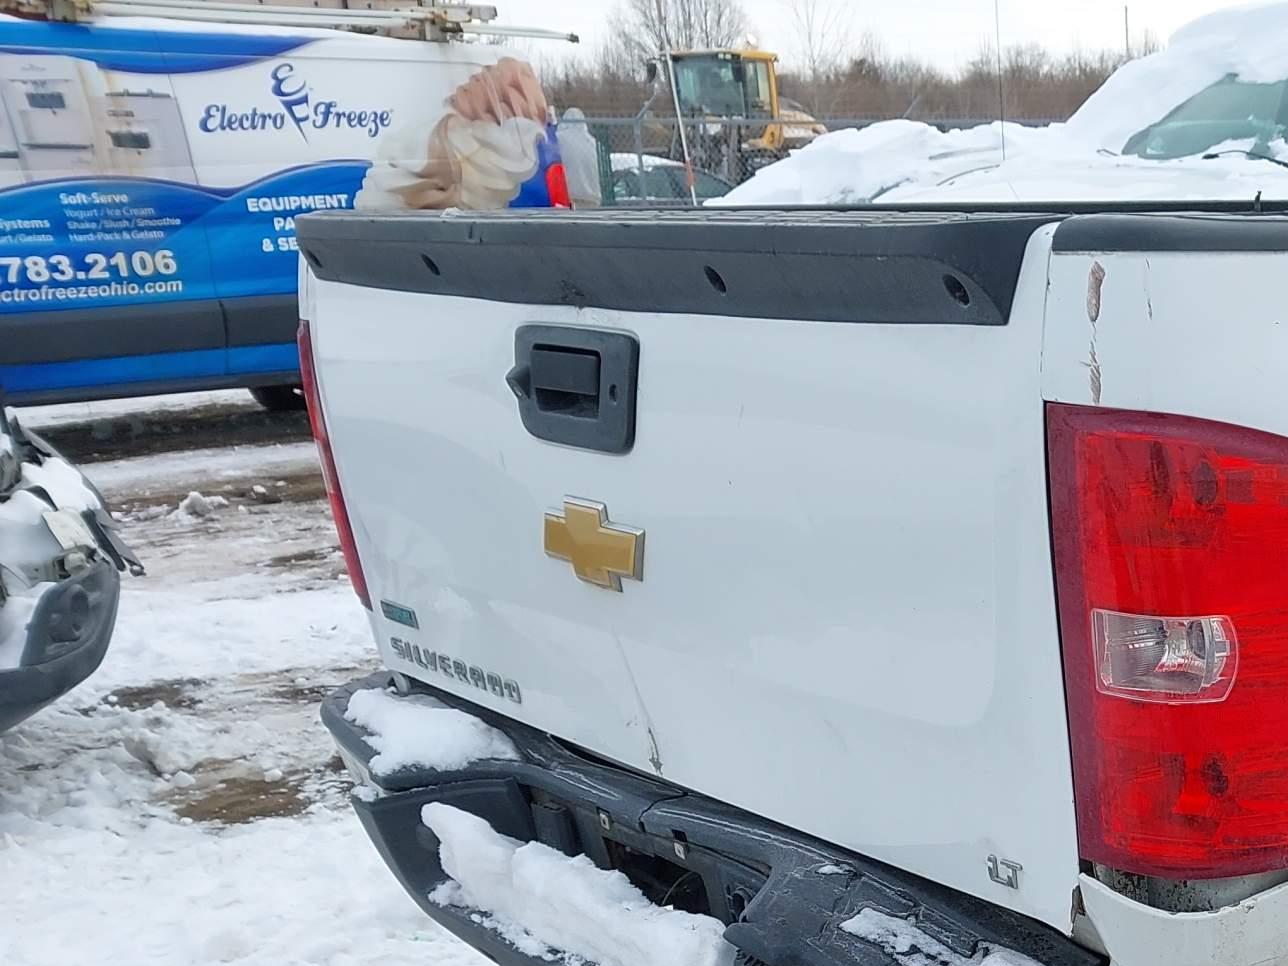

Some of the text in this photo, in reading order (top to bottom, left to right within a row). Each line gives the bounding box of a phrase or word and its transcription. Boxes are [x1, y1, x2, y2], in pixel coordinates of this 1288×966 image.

[199, 101, 391, 138] Electro Freeze
[59, 192, 128, 205] Soft-Serve
[247, 194, 348, 213] EQUIPMENT
[64, 208, 98, 219] Yogurt
[122, 206, 155, 216] Cream
[136, 216, 182, 227] Smoothie
[262, 238, 275, 252] &
[0, 249, 177, 284] 783.2106
[0, 279, 183, 303] ctrofreezeohio.com
[390, 636, 522, 705] SILVERADO
[987, 853, 1023, 890] LT
